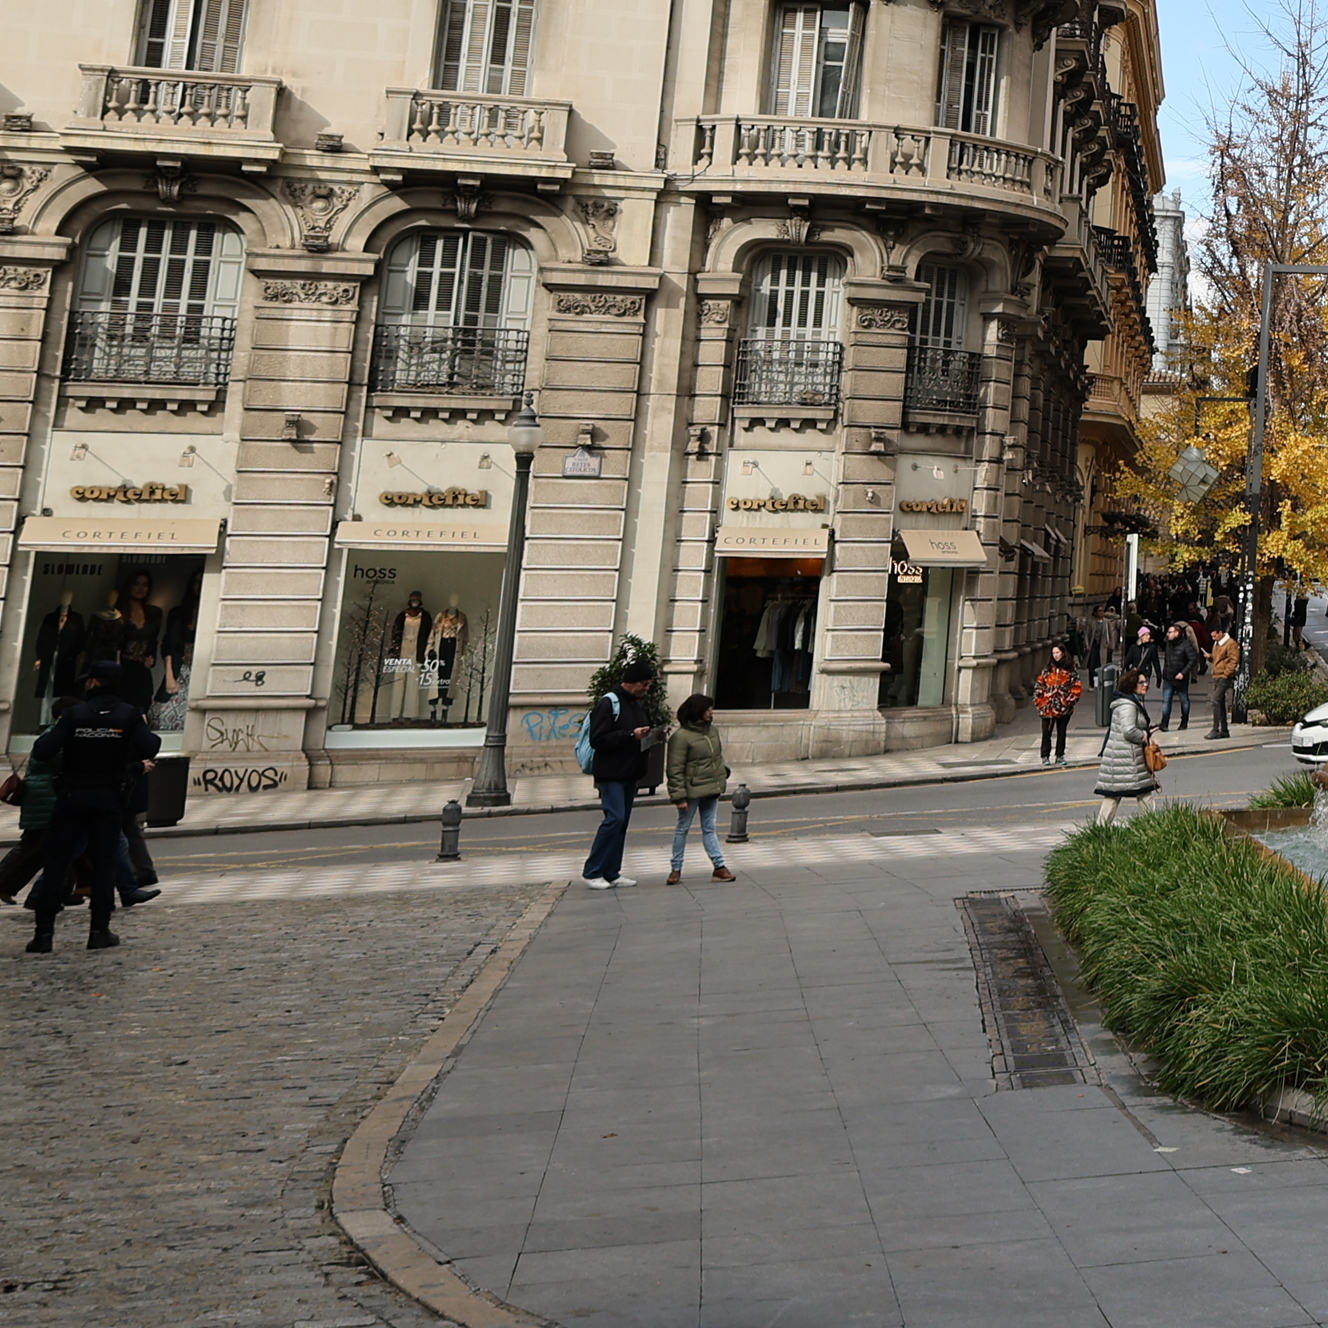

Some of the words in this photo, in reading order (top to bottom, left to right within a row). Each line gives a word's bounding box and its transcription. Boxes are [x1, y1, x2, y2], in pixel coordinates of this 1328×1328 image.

[70, 481, 189, 503] cortefiel
[379, 486, 488, 509] cortefiel
[727, 493, 828, 513] cortefiel
[62, 530, 178, 541] CORTEFIEL
[373, 528, 480, 539] CORTEFIEL
[723, 536, 821, 545] CORTEFIEL
[928, 538, 957, 551] hoss
[353, 564, 397, 579] hoss
[383, 658, 412, 666] VENTA
[382, 665, 416, 673] ESPECIAL
